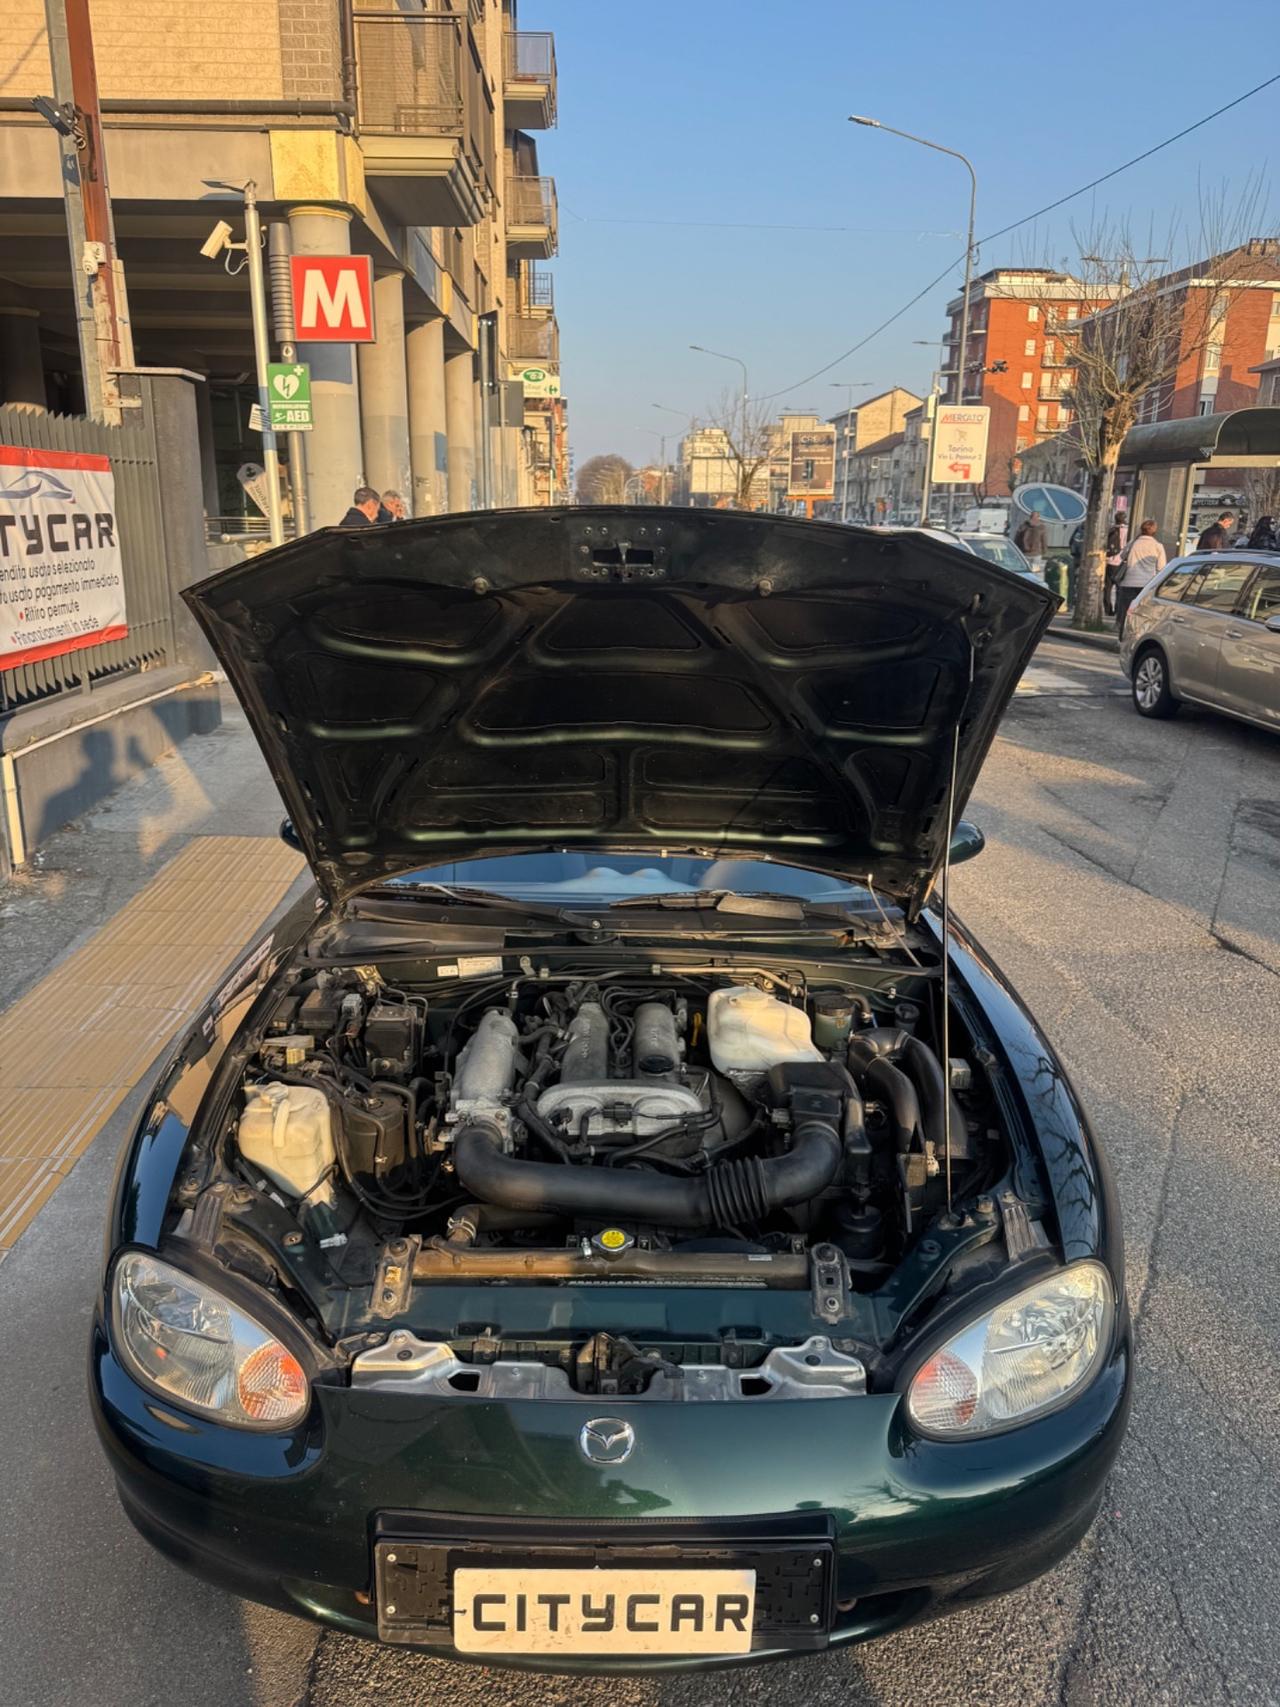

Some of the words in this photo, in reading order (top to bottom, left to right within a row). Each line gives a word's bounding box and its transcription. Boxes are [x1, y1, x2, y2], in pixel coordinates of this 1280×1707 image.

[301, 269, 367, 328] M
[286, 410, 310, 422] AED
[948, 444, 974, 452] Torino
[29, 561, 51, 578] usato
[52, 557, 96, 575] selezionato
[9, 586, 32, 603] usato
[35, 579, 80, 602] pagamento
[81, 574, 120, 591] immediato
[24, 605, 45, 622] Ritiro
[47, 600, 80, 620] permute
[14, 620, 73, 646] Finanziamenti
[80, 615, 100, 631] sede
[472, 1593, 749, 1632] CITYCAR
